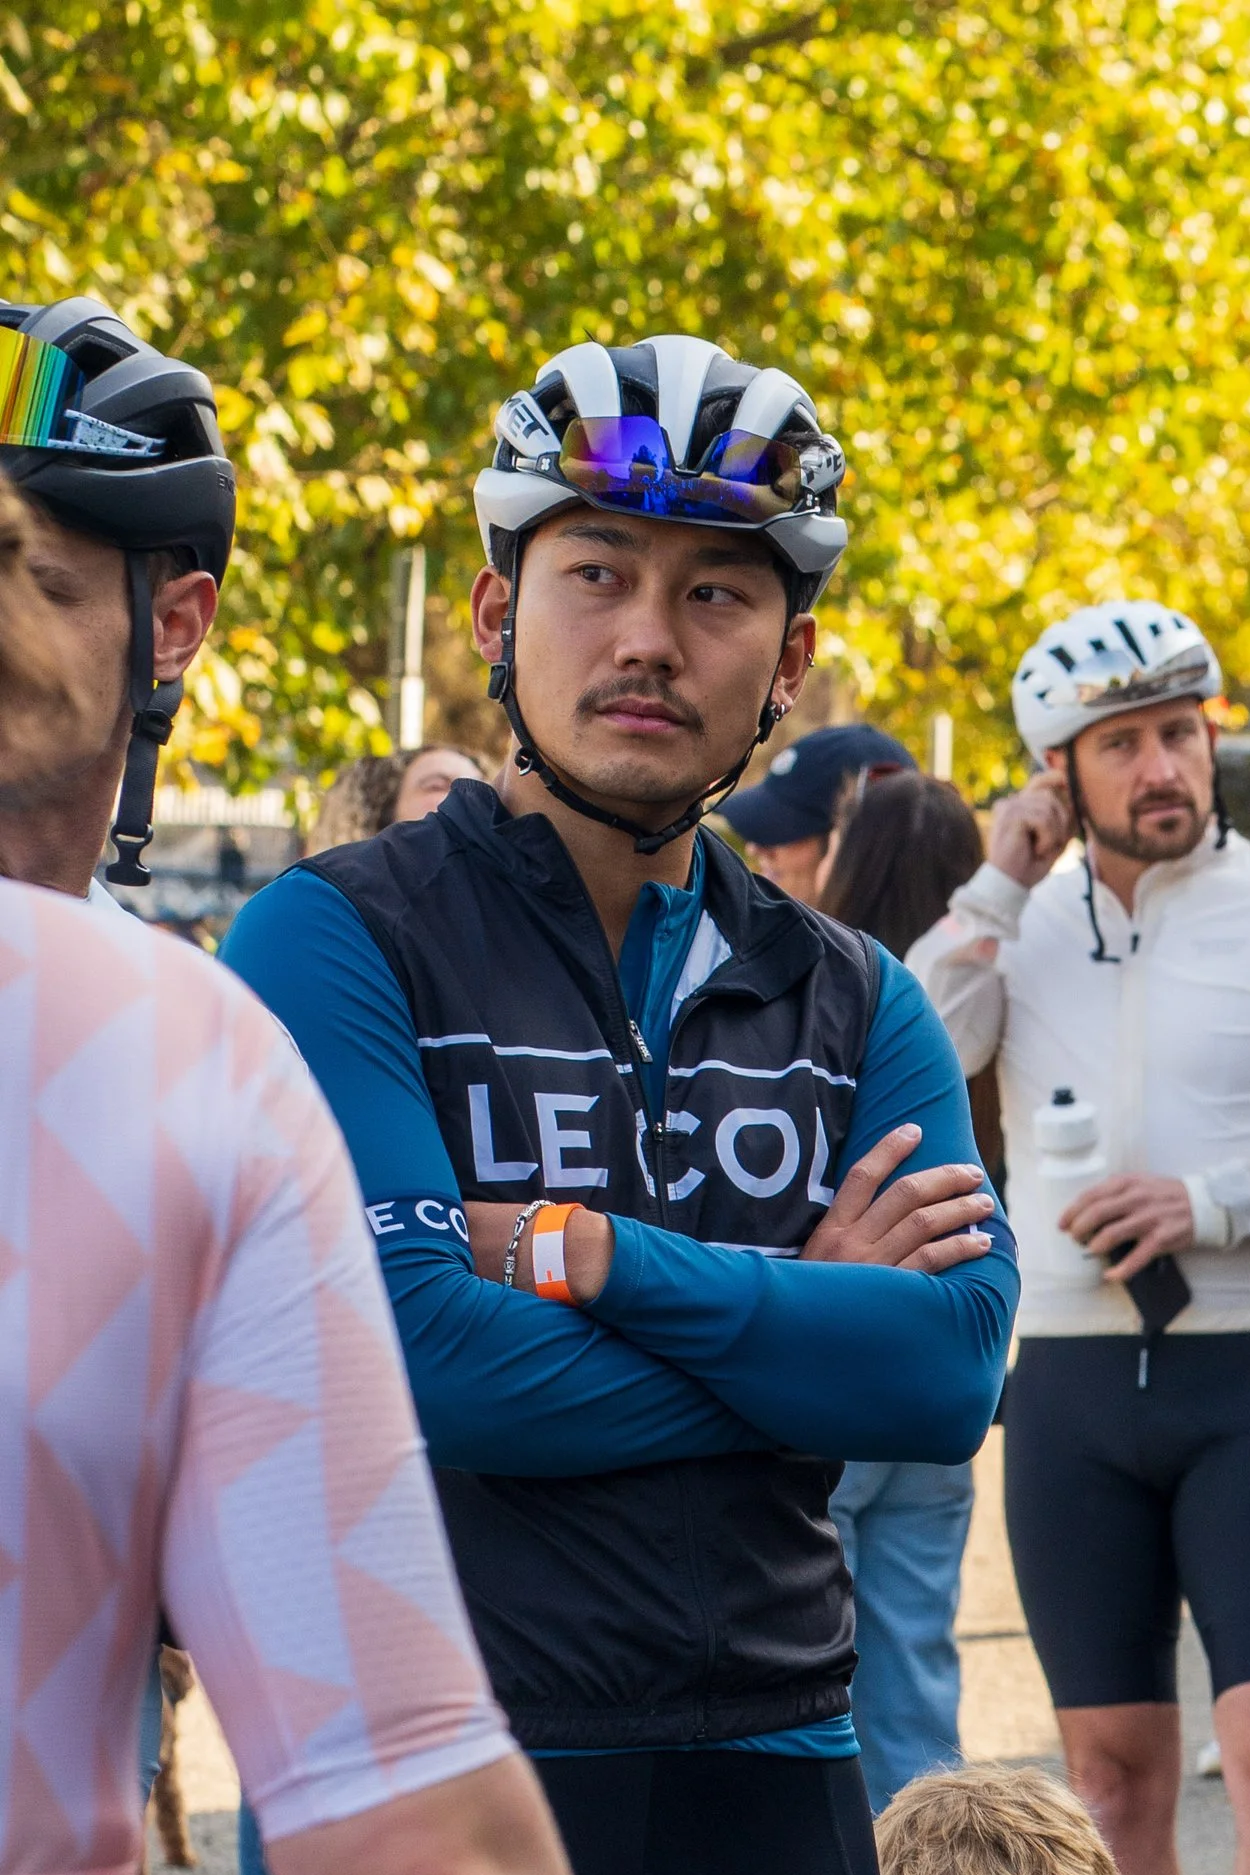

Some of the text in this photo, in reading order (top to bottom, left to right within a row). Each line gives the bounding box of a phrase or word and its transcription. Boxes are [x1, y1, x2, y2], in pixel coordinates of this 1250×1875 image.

[468, 1084, 835, 1207] LE COL
[364, 1199, 470, 1243] E CO
